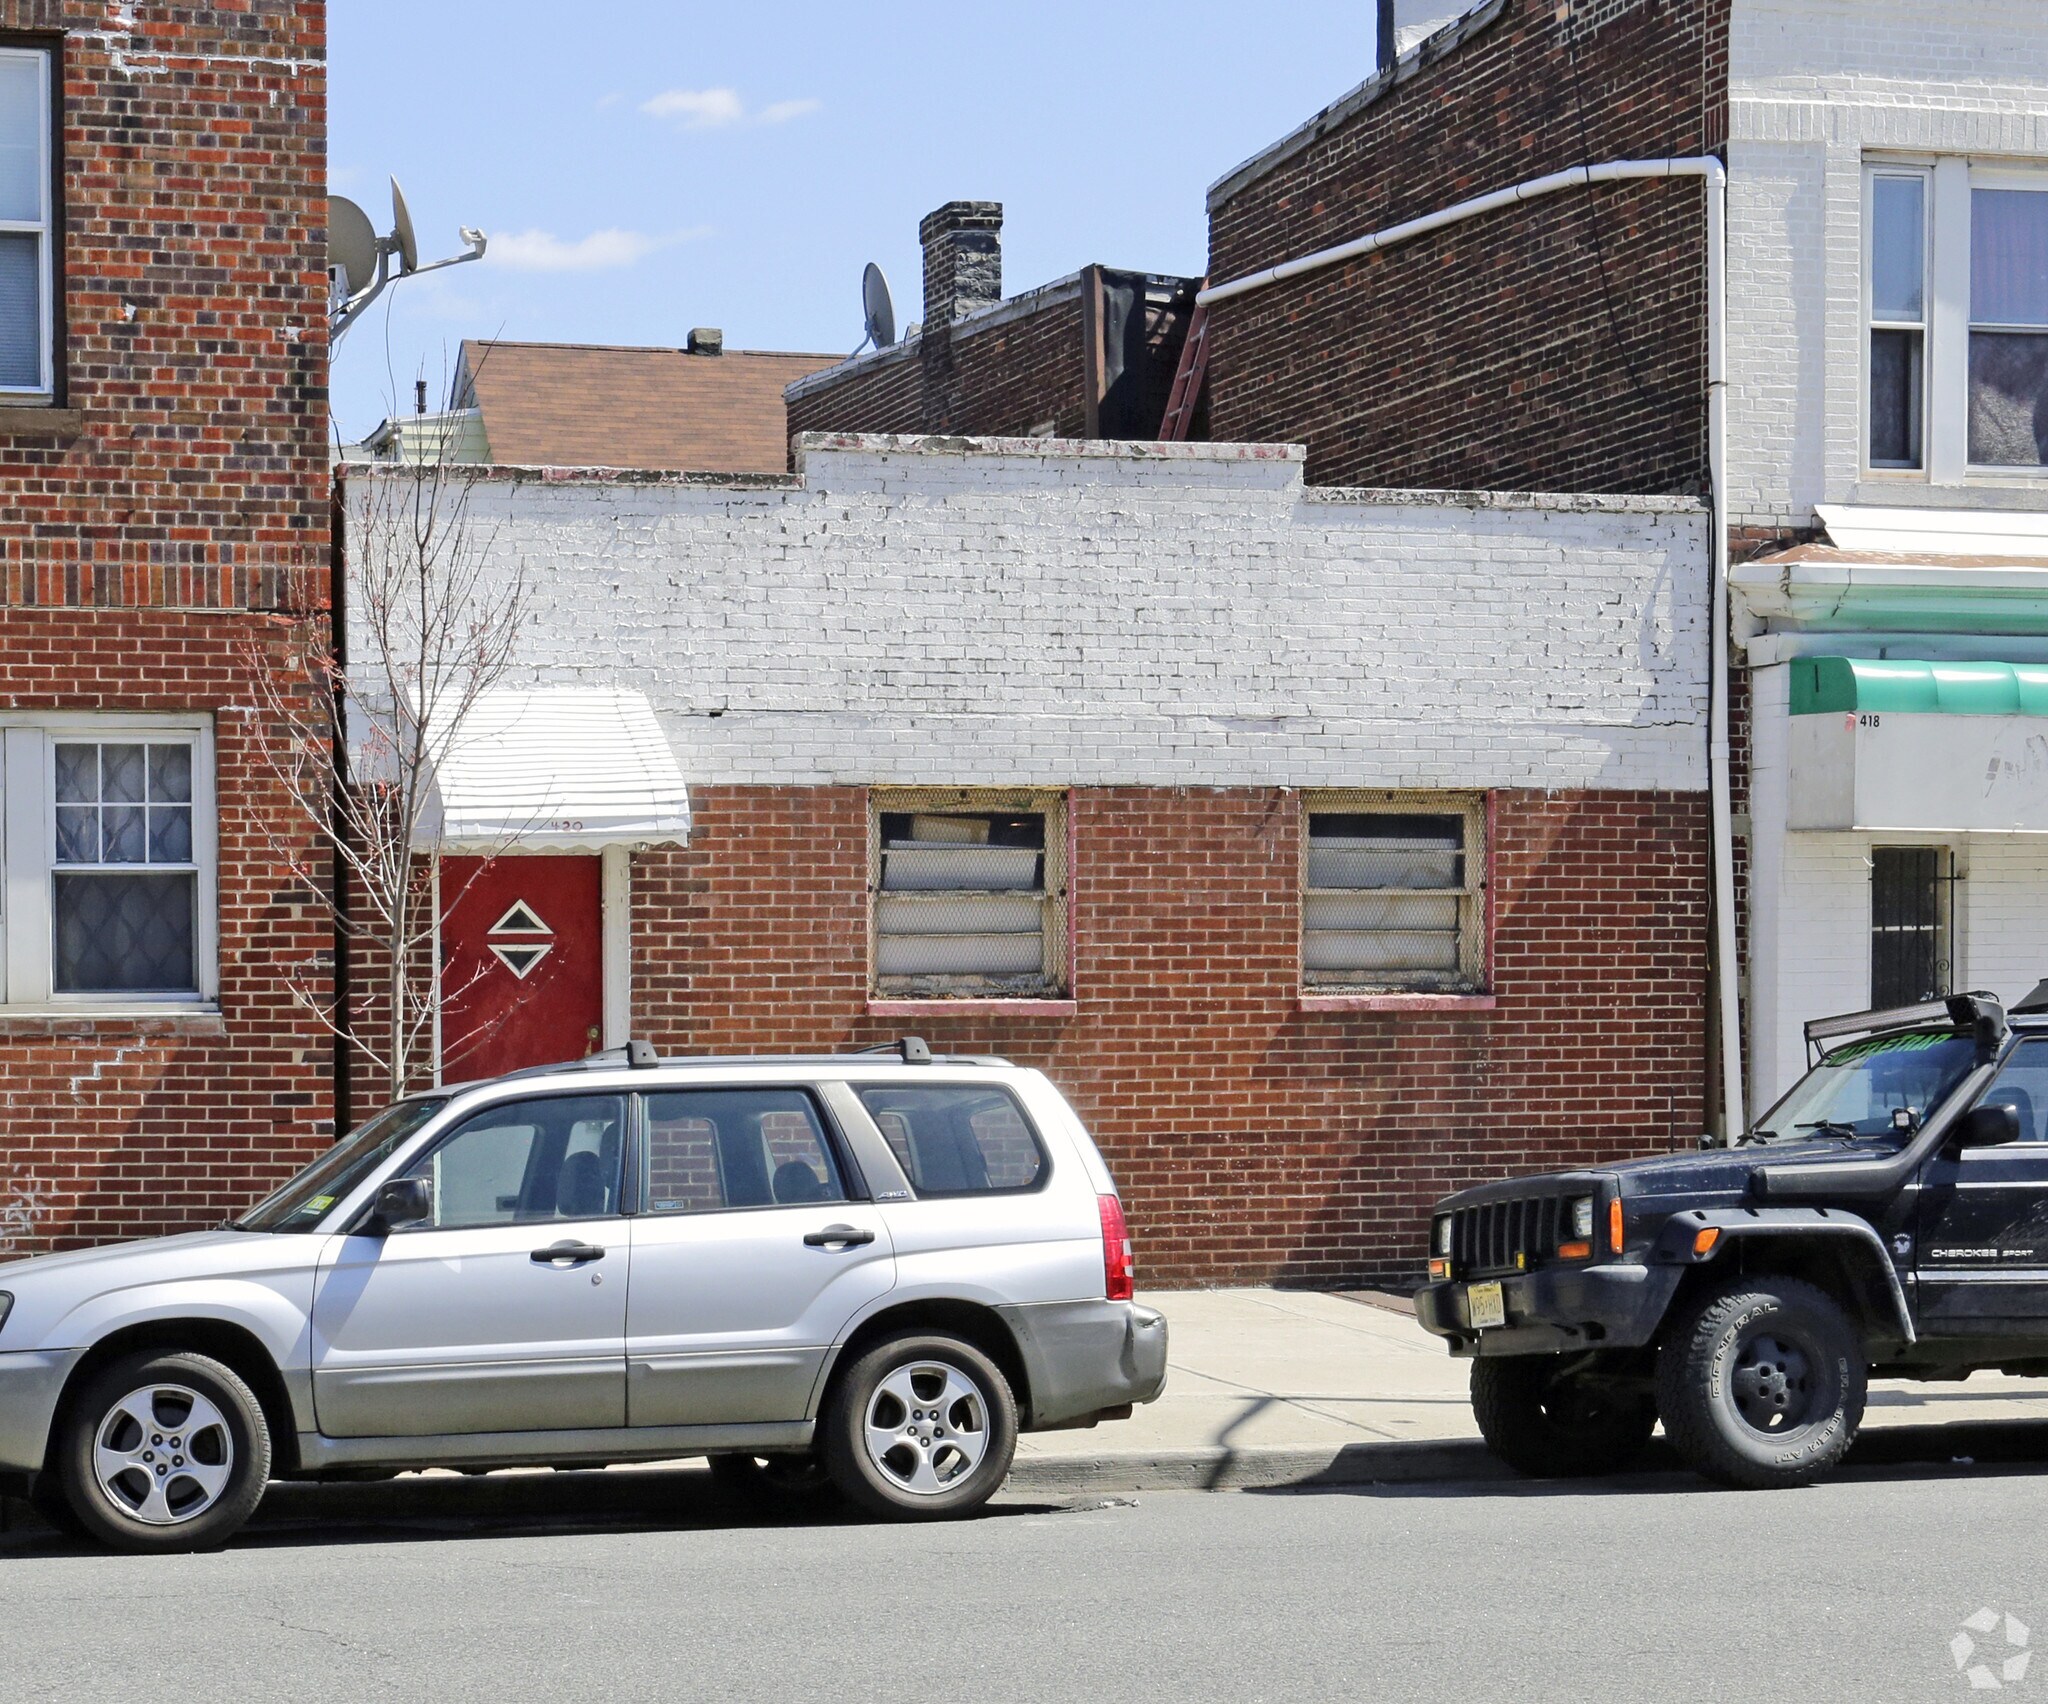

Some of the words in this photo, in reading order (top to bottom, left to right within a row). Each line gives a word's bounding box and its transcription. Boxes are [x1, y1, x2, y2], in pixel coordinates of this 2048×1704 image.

[1860, 715, 1880, 728] 418
[551, 820, 583, 832] 420
[1931, 1249, 1998, 1258] CHEROKEE
[2002, 1249, 2034, 1257] SPORT
[1711, 1303, 1778, 1399] GENERAL
